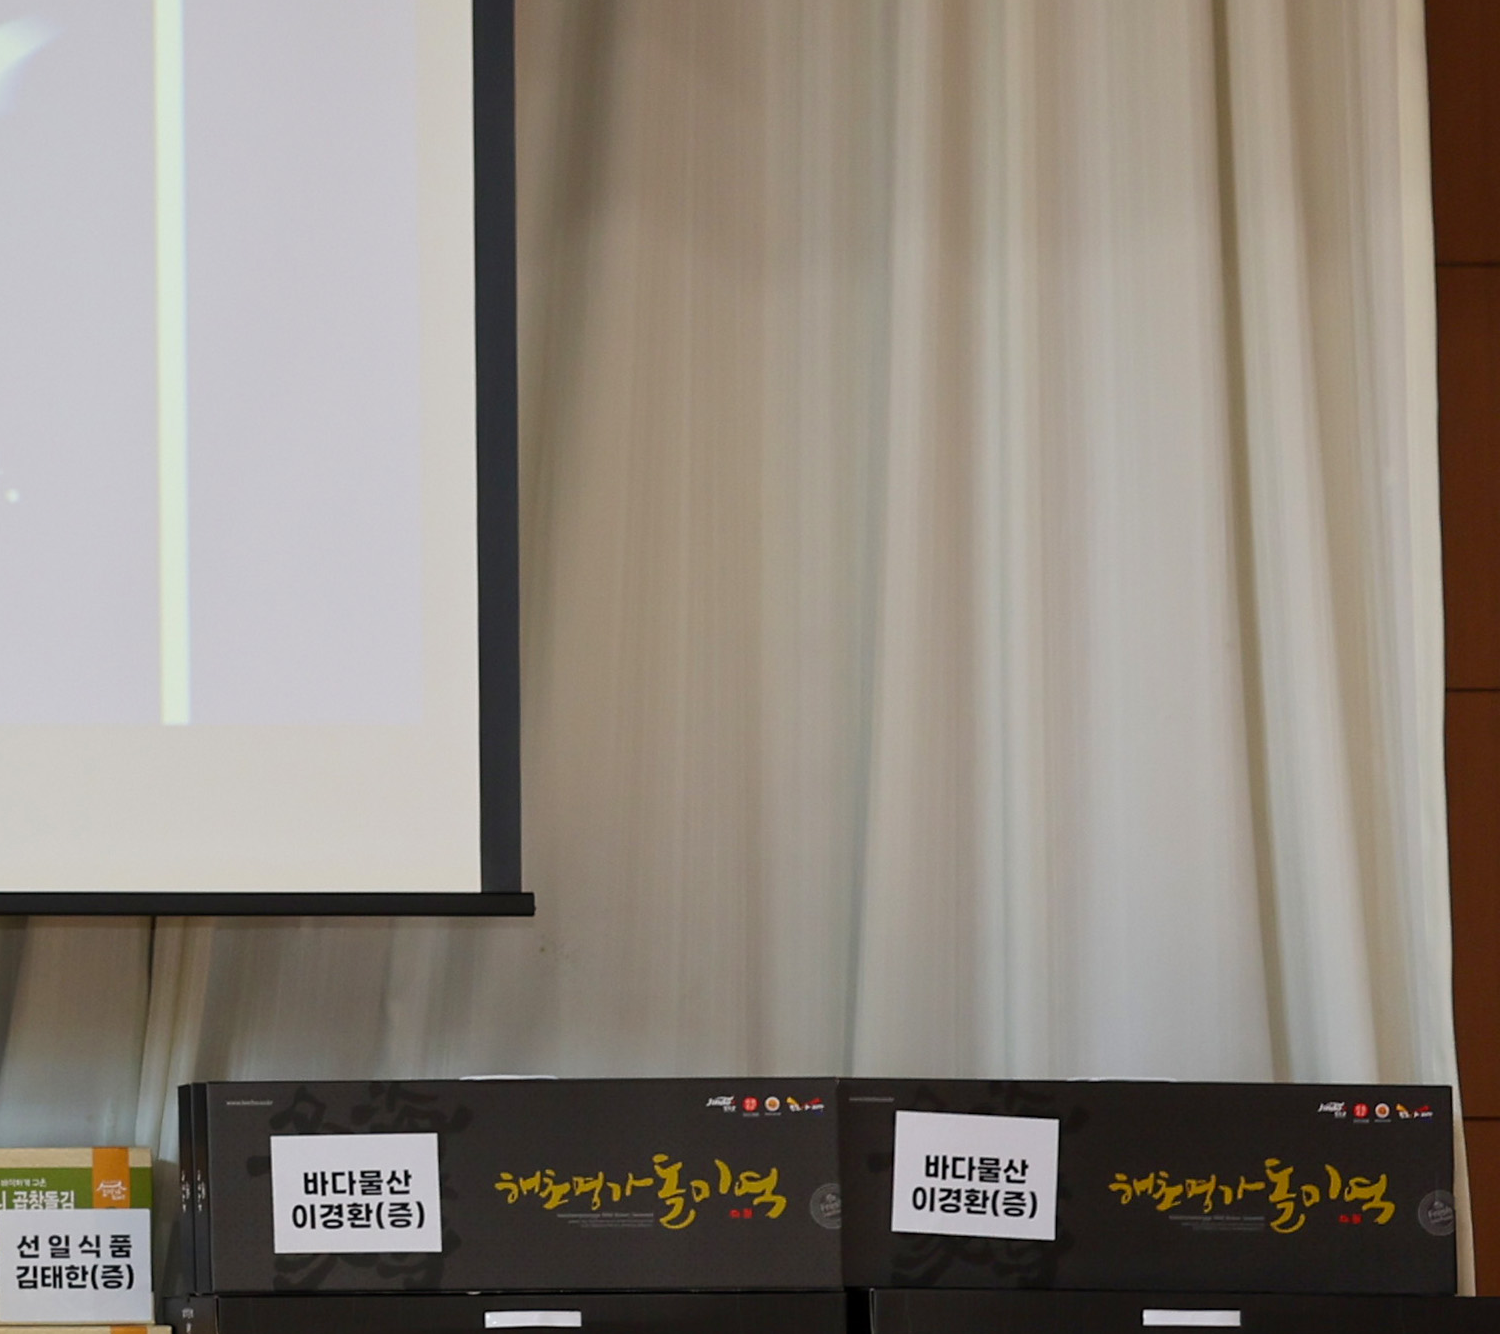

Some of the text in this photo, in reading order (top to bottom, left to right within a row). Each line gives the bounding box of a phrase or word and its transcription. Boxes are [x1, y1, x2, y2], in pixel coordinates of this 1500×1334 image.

[304, 1170, 411, 1196] 바다물산
[925, 1155, 1028, 1184] 바다물산
[913, 1182, 1037, 1218] 이경환(증)
[293, 1202, 424, 1229] 이경환(증)
[17, 1264, 134, 1290] 김태한(증)
